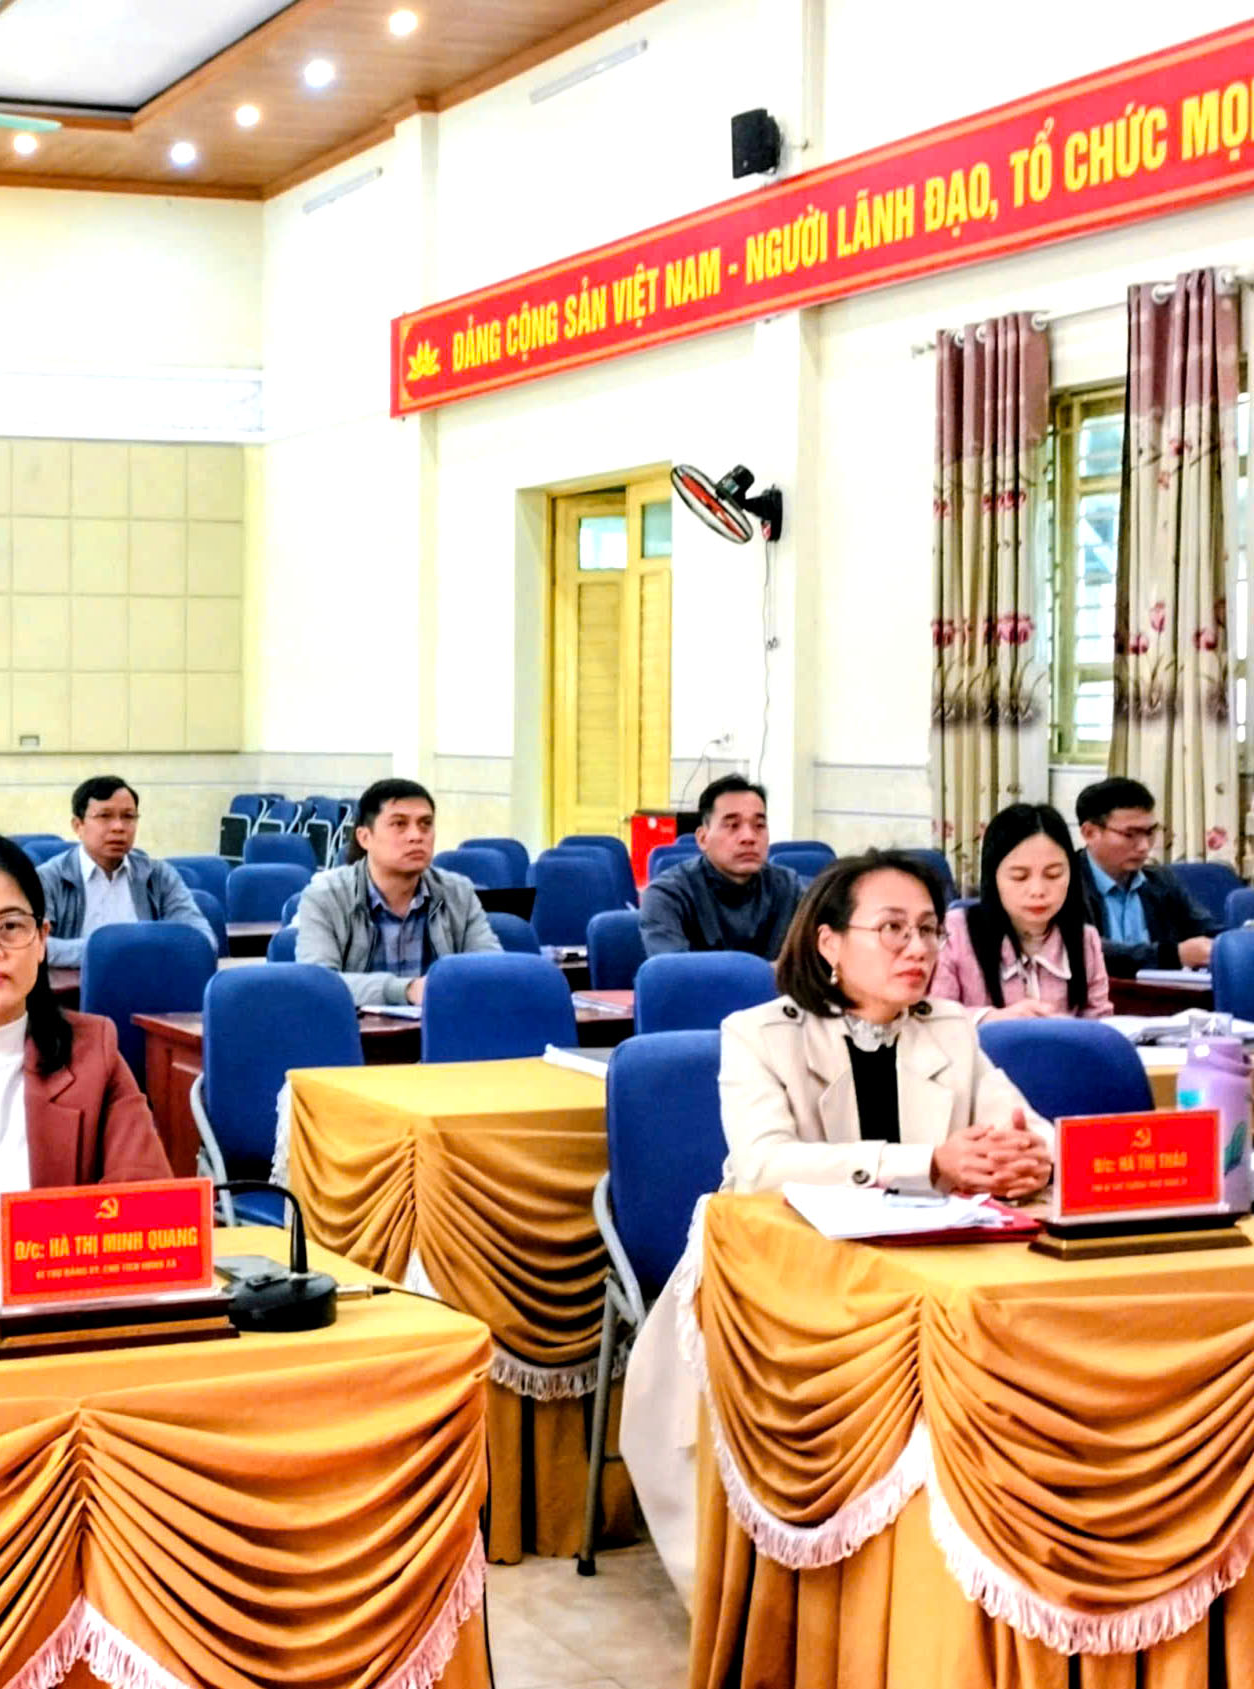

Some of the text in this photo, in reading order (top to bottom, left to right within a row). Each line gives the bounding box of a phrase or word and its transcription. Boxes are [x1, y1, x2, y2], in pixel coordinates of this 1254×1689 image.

[452, 314, 502, 373] ĐẢNG
[506, 301, 559, 362] CỘNG
[564, 276, 608, 340] SẢN
[612, 263, 660, 328] VIỆT
[665, 247, 722, 309] NAM
[728, 263, 739, 276] -
[746, 203, 828, 286] NGƯỜI
[837, 184, 915, 259] LÃNH
[923, 162, 999, 237] ĐẠO,
[1009, 117, 1055, 208] TỔ
[1064, 102, 1168, 193] CHỨC
[49, 1233, 70, 1258] HÀ
[74, 1234, 98, 1259] THỊ
[102, 1231, 144, 1254] MINH
[147, 1226, 199, 1251] QUANG
